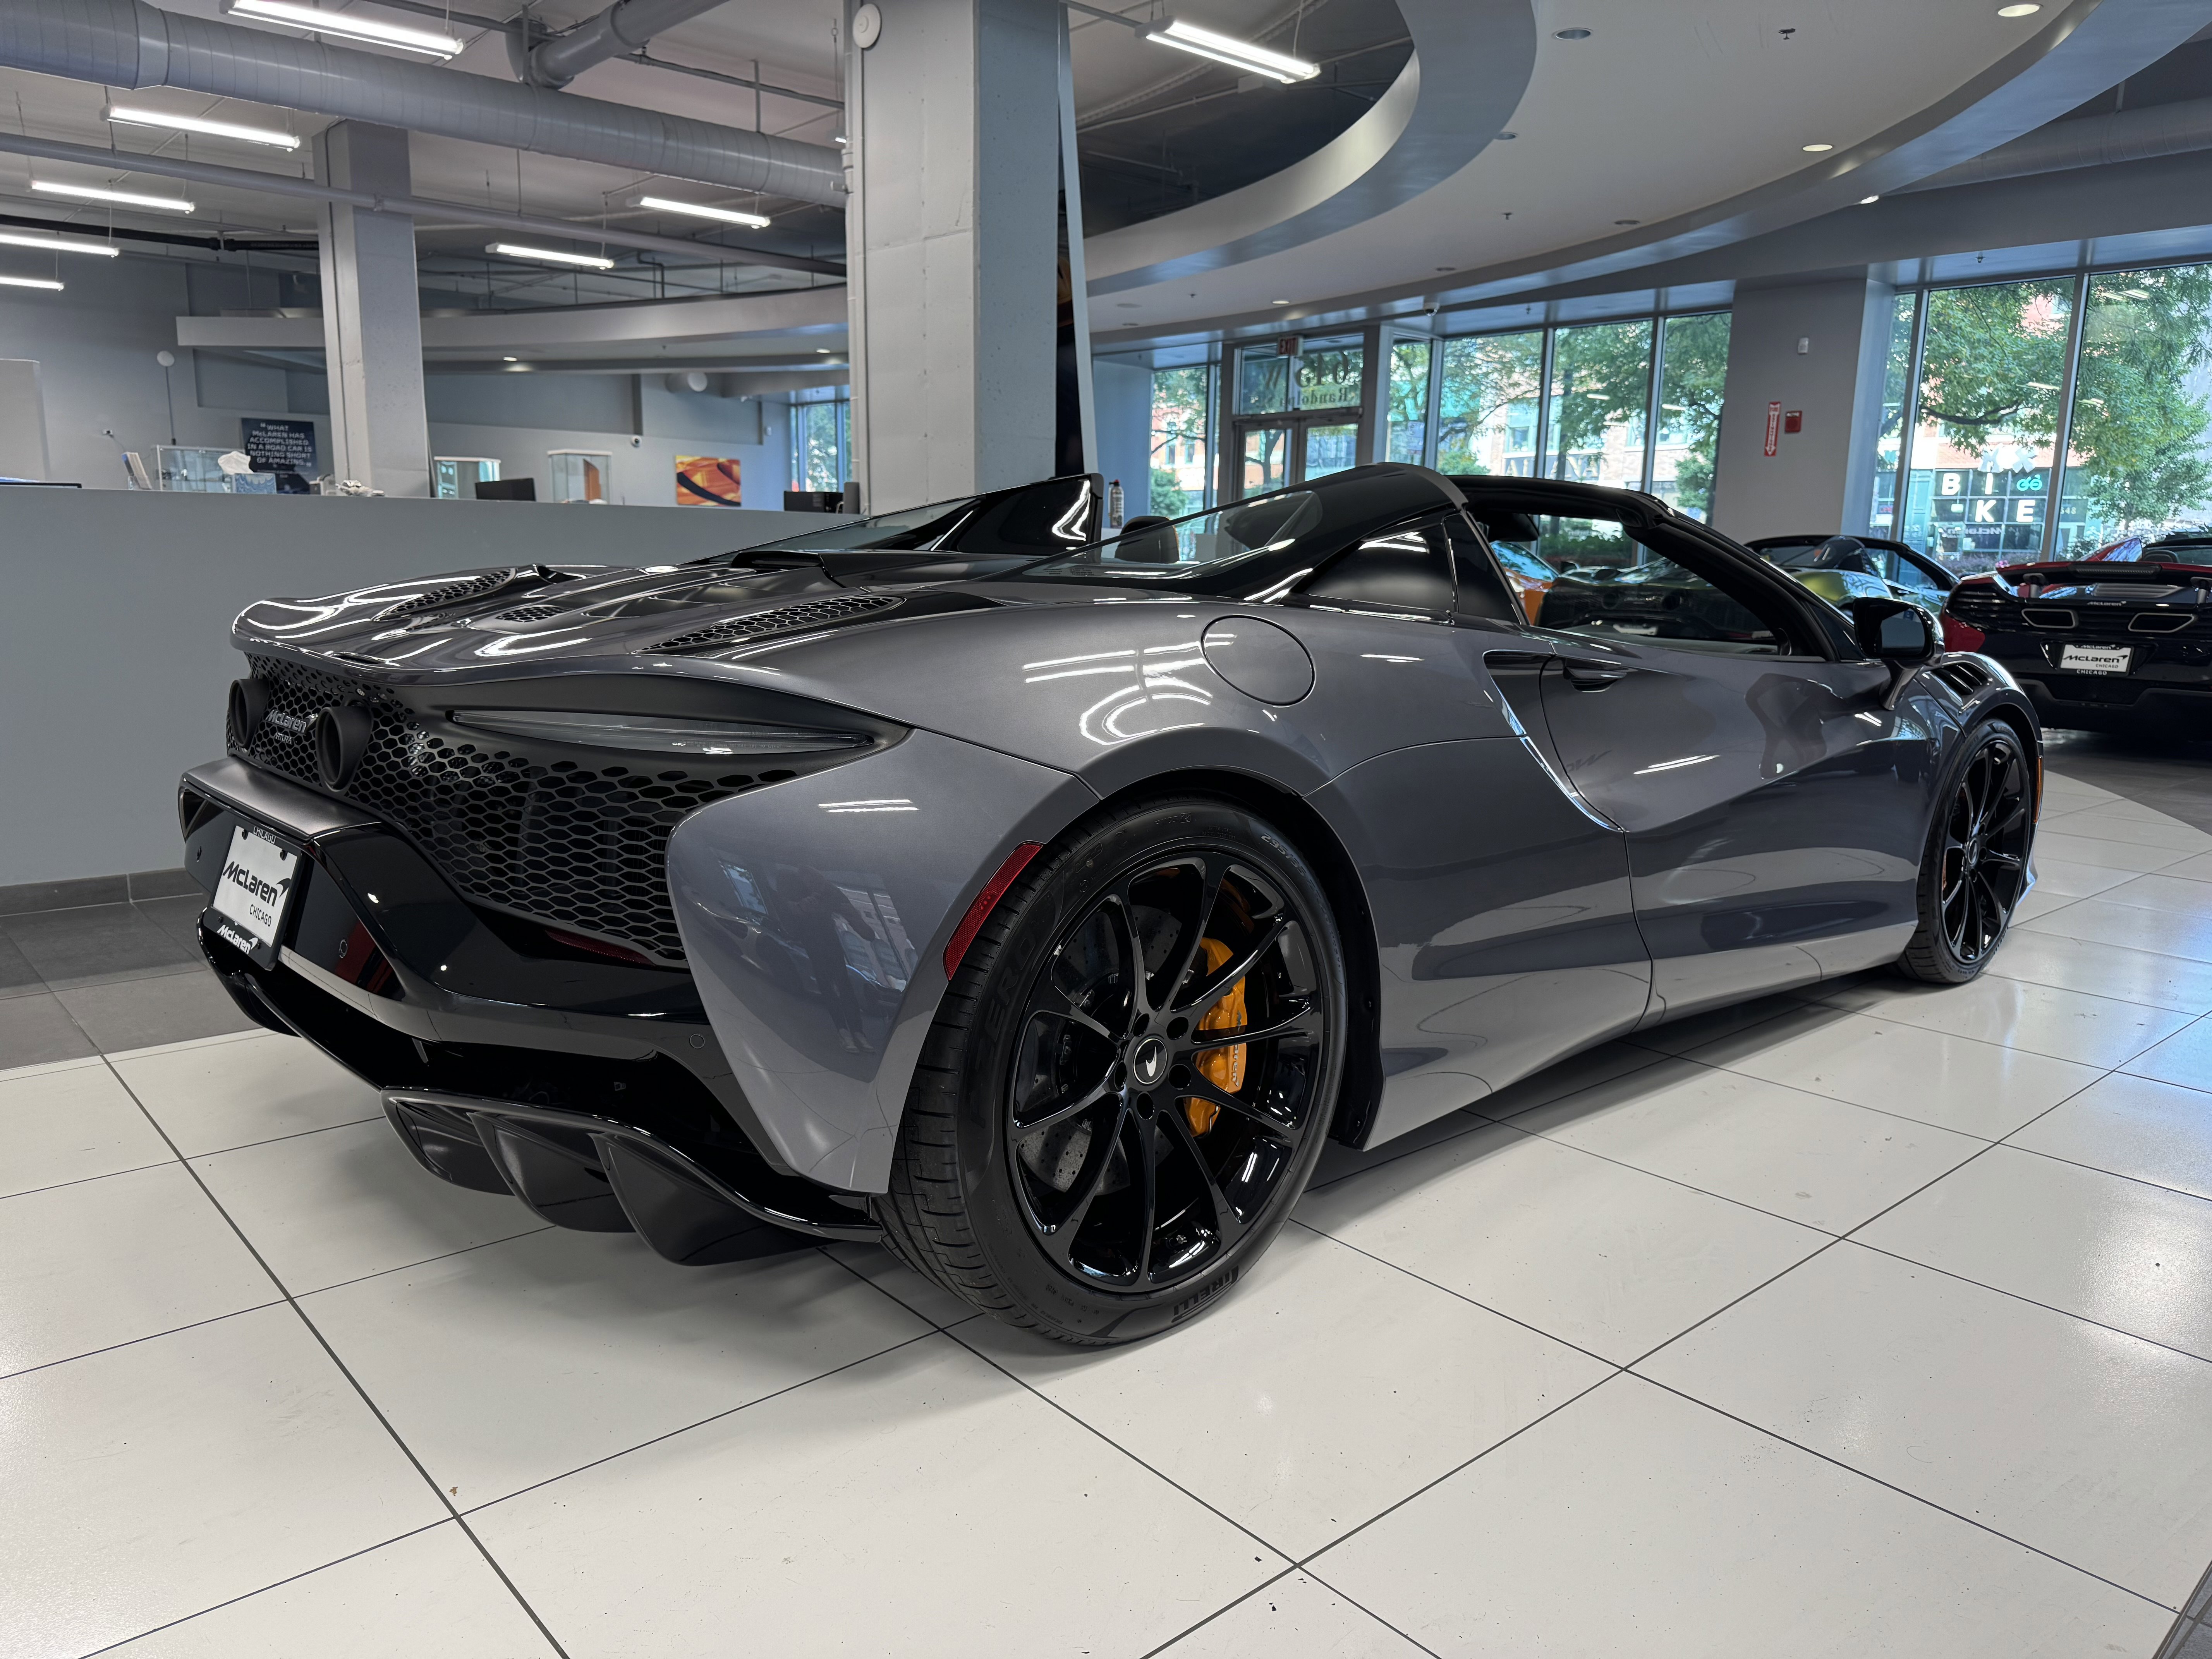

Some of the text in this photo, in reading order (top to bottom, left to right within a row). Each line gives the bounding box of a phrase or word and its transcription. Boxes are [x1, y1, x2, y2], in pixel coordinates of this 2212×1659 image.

[250, 437, 309, 445] ACCOMPLISHED
[2063, 655, 2120, 663] McLaren
[265, 709, 307, 733] McLaren
[273, 732, 292, 744] ARTURA
[222, 861, 278, 907] McLaren
[249, 904, 271, 927] CHICAGO
[217, 924, 251, 955] McLaren
